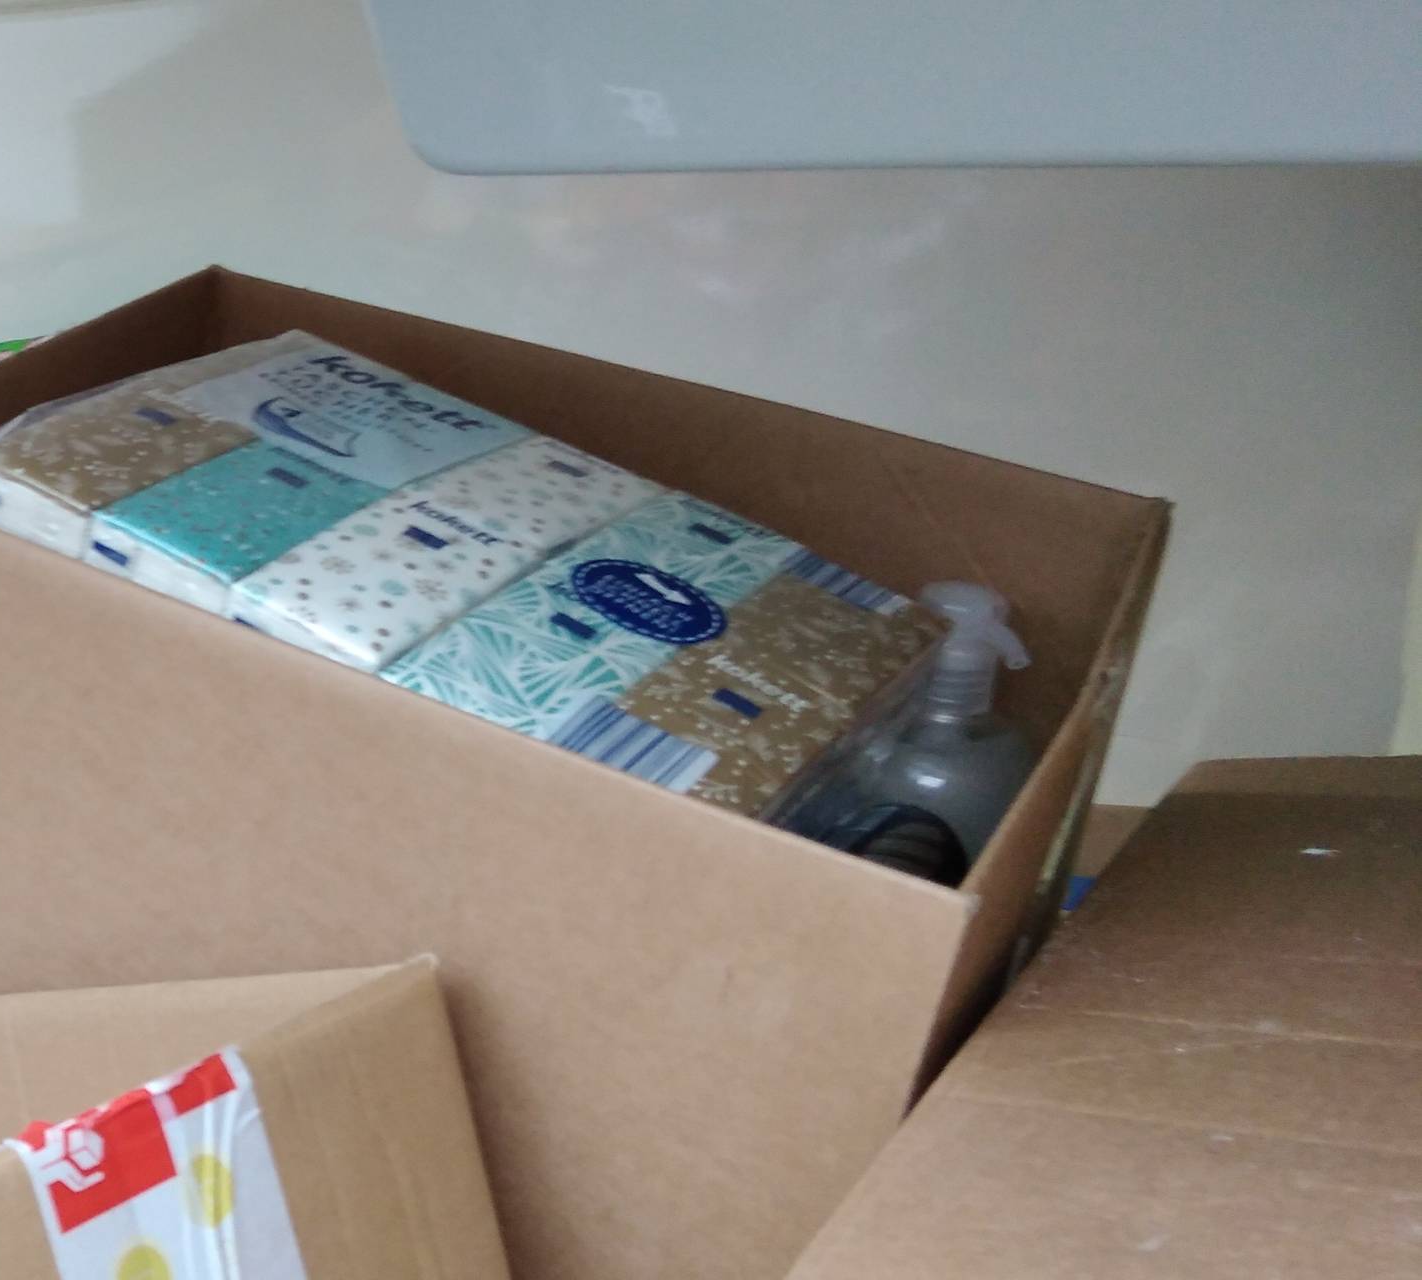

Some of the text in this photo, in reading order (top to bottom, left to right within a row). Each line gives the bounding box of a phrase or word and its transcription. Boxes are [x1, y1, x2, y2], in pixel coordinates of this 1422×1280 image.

[307, 356, 495, 431] kokett
[409, 500, 504, 546] kokett
[705, 654, 810, 712] kokett
